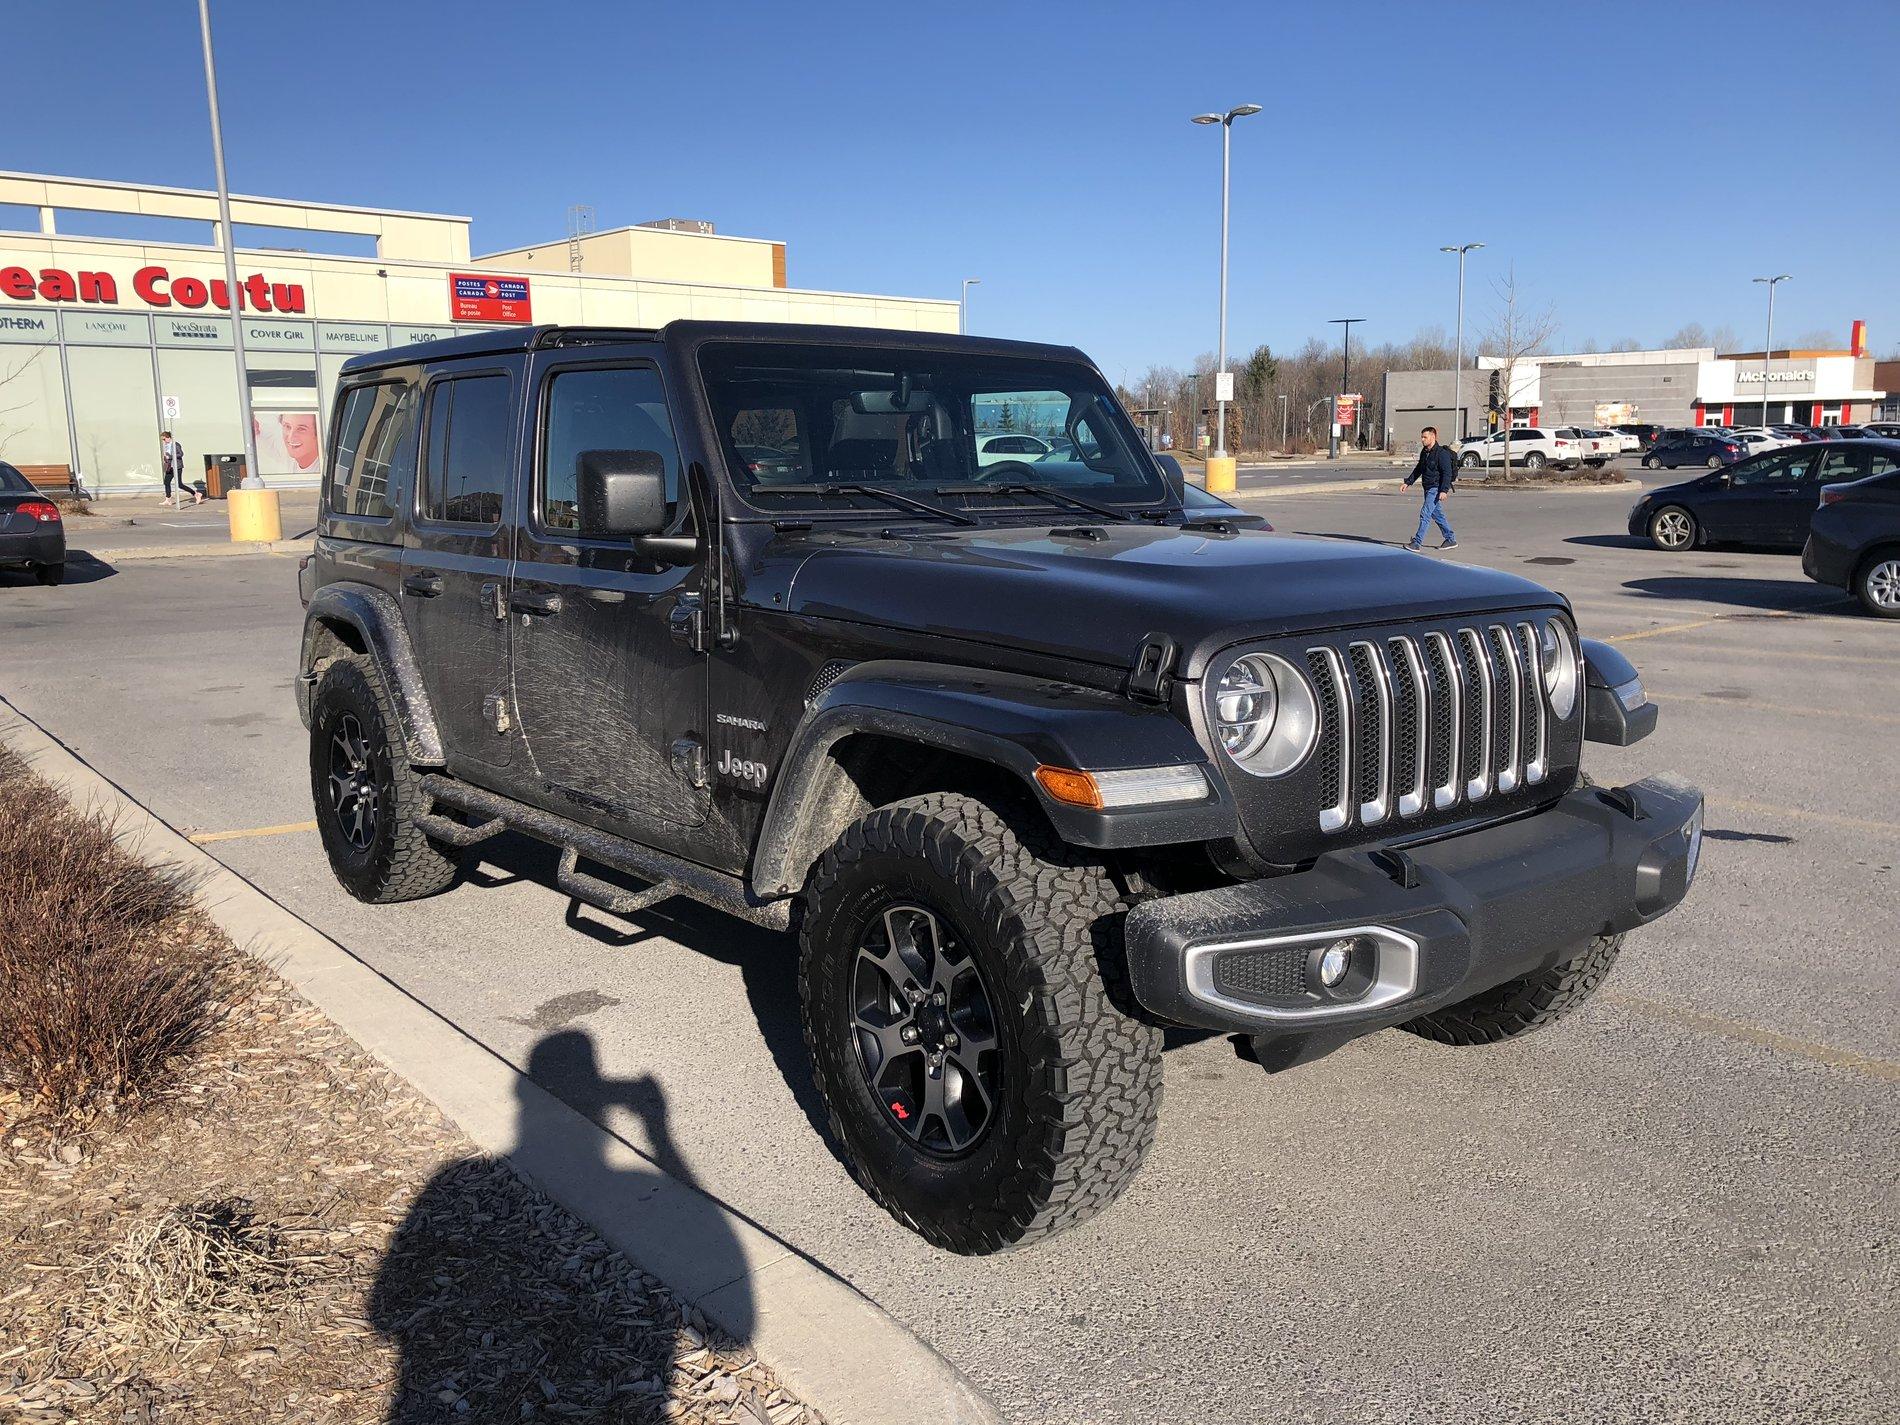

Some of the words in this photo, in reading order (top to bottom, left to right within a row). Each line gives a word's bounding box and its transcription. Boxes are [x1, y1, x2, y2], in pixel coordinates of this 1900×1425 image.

[132, 266, 306, 314] Coutu
[326, 332, 379, 342] MAYBELLINE
[410, 332, 437, 342] HUGO
[1736, 370, 1815, 383] McDonald's
[716, 713, 767, 732] SAHARA
[717, 749, 767, 788] Jeep
